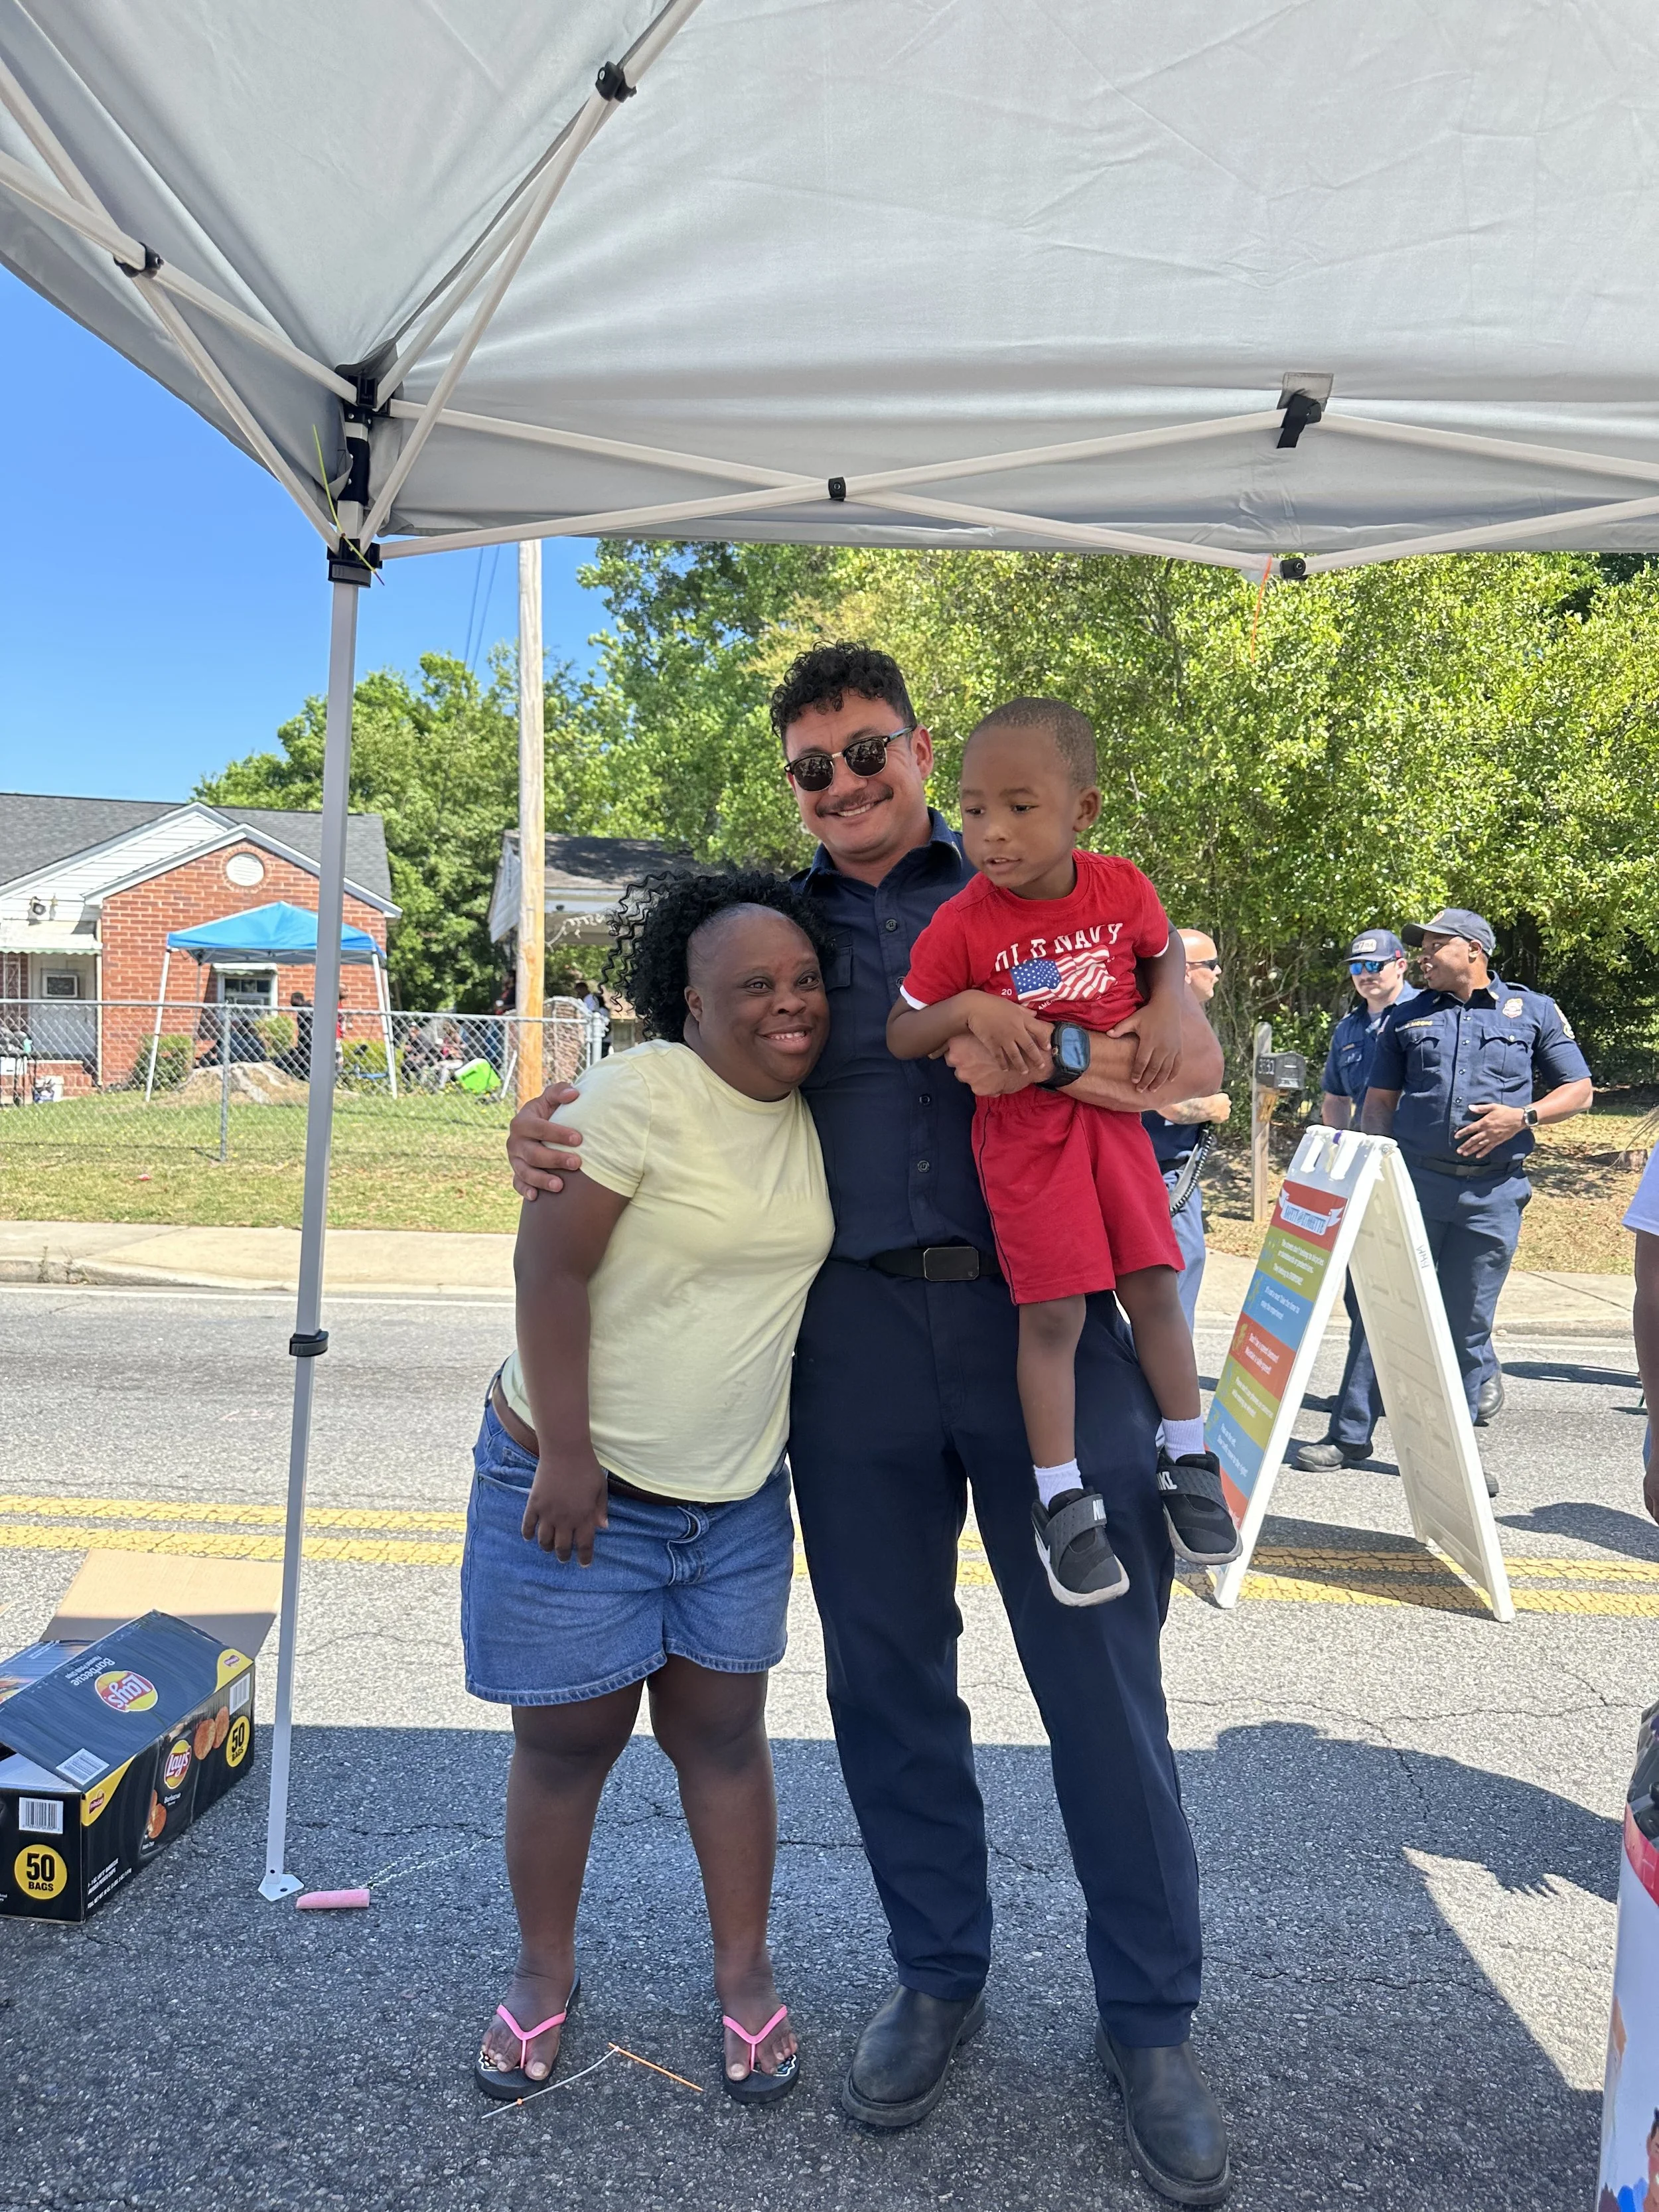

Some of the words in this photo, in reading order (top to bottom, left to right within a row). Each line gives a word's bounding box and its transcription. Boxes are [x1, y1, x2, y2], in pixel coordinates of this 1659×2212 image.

[995, 938, 1046, 972] OLD
[1054, 922, 1123, 954] NAVY
[70, 1657, 116, 1686] Barbecue
[108, 1674, 152, 1708] Lay's
[232, 1722, 245, 1753] 50
[166, 1751, 190, 1778] Lay's
[232, 1746, 244, 1762] BAGS
[27, 1852, 56, 1882] 50
[29, 1881, 54, 1891] BAGS
